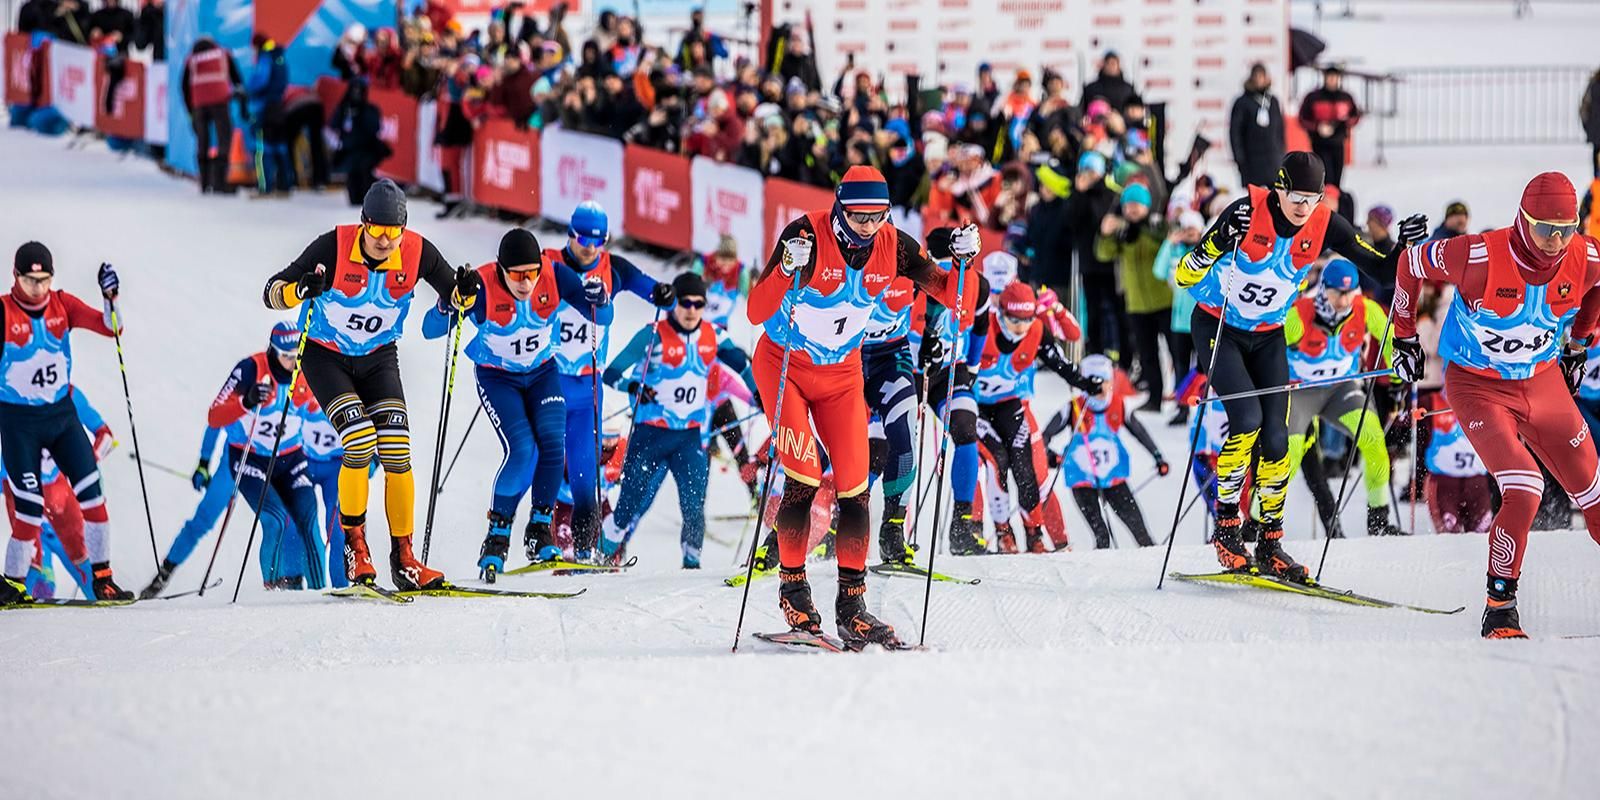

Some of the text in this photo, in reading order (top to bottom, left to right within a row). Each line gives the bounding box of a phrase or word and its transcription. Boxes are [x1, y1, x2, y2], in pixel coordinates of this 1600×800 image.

[1239, 282, 1277, 306] 53
[346, 313, 383, 333] 50
[560, 322, 588, 344] 54
[834, 316, 848, 335] 1
[510, 334, 540, 355] 15
[31, 363, 58, 388] 45
[674, 386, 697, 404] 90
[482, 396, 502, 430] CRAFT
[312, 430, 337, 448] 12
[1569, 421, 1589, 449] BOS
[1454, 452, 1476, 470] 57
